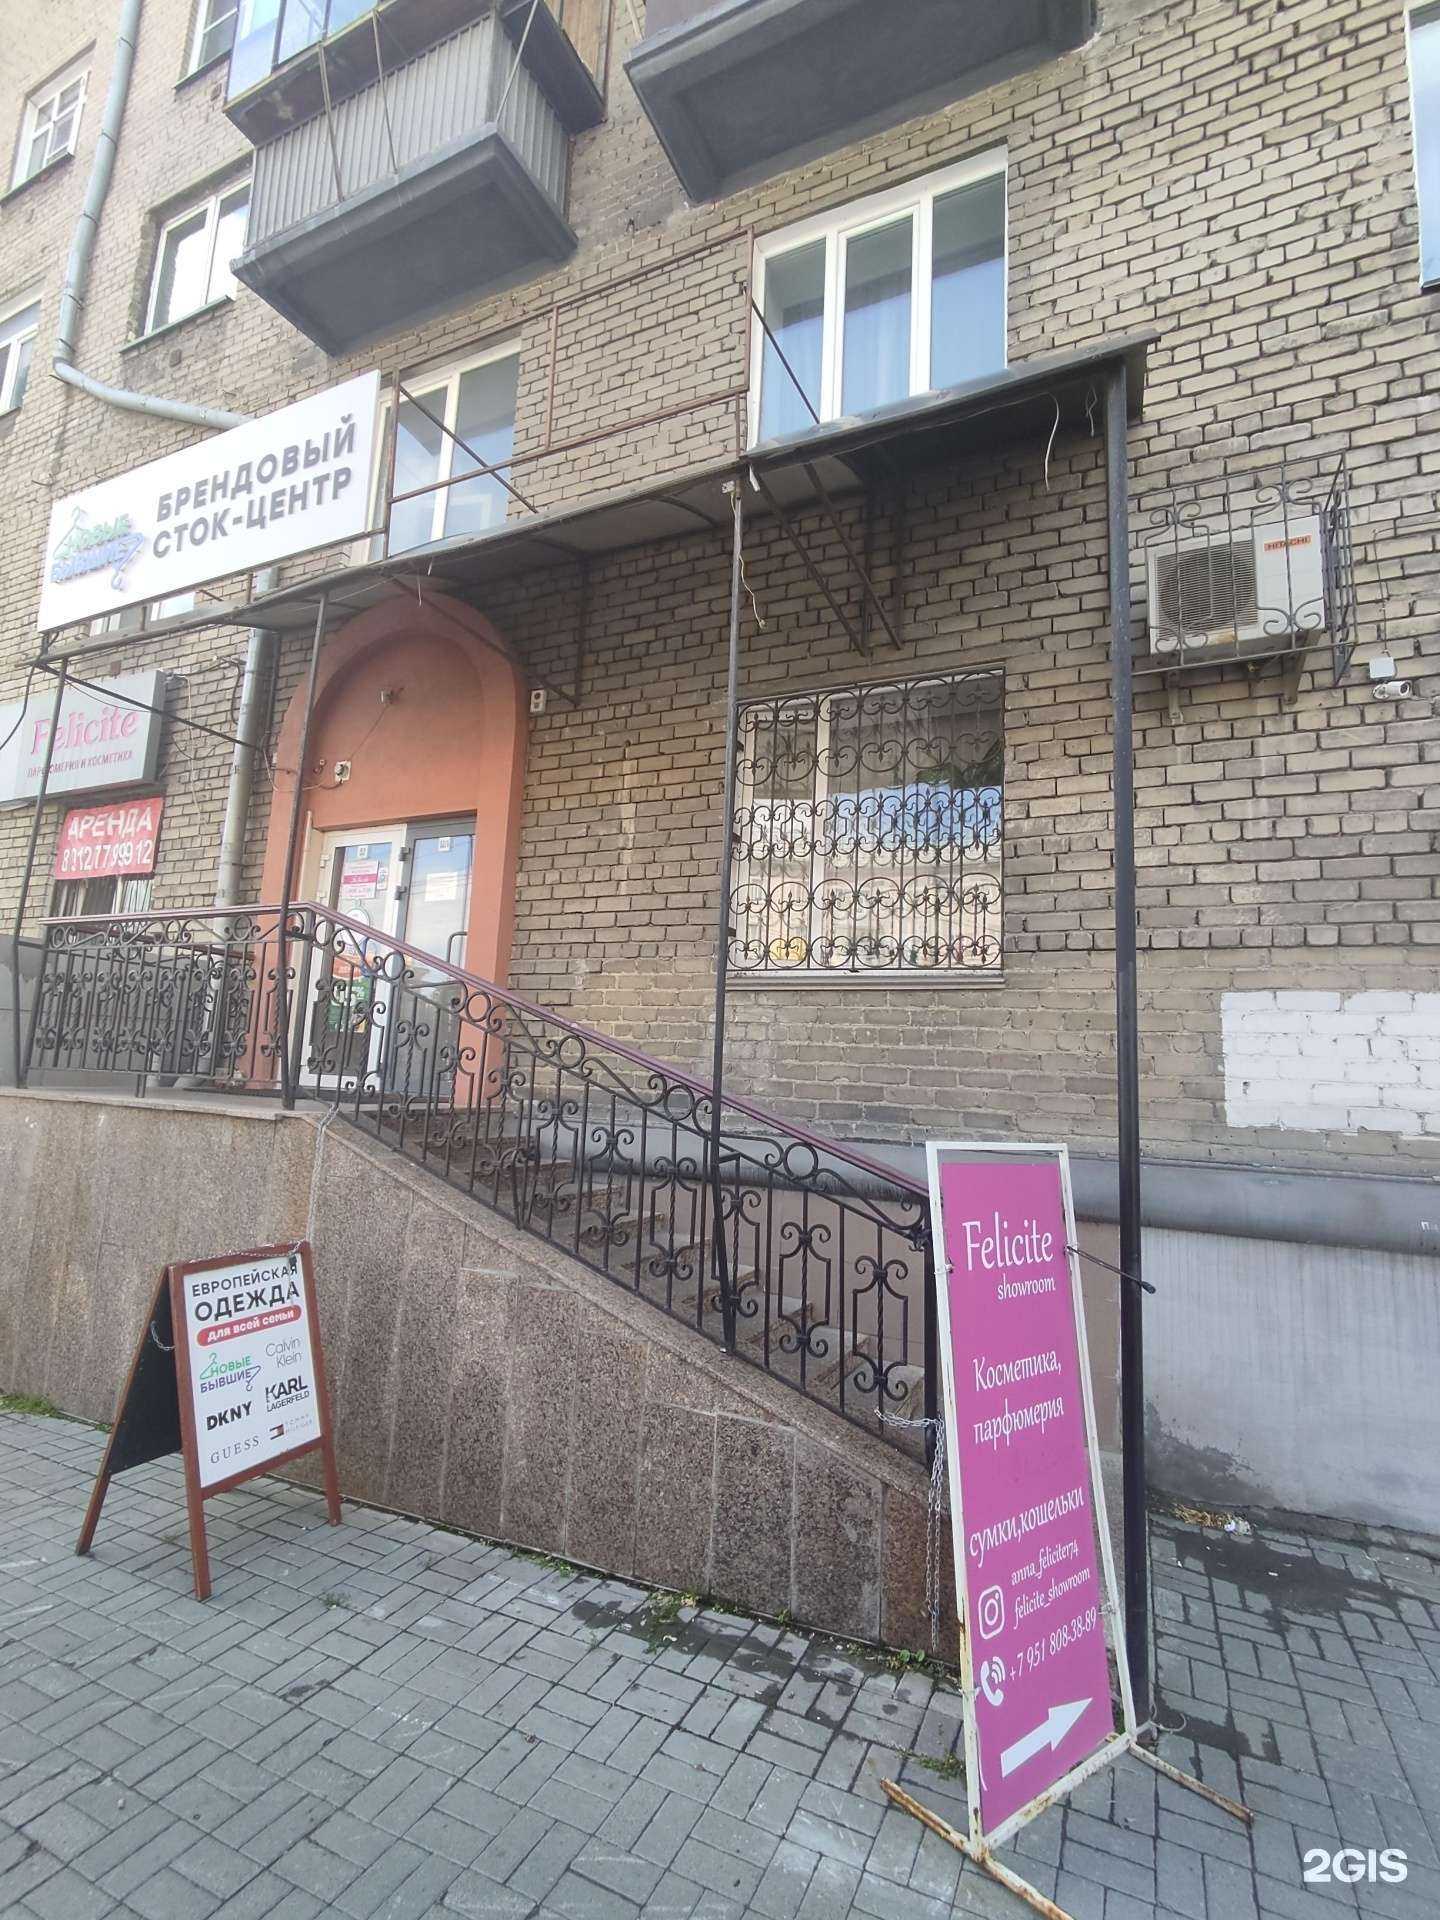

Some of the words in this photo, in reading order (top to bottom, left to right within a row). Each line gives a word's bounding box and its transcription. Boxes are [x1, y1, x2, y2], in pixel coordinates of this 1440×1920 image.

[156, 413, 357, 523] БРЕНДОВЫЙ
[152, 466, 352, 559] СТОК-ЦЕНТР
[31, 708, 139, 757] Felicite
[68, 806, 153, 841] АРЕНДА
[962, 1211, 1054, 1271] Felicite
[192, 1263, 298, 1297] ЕВРОПЕЙСКАЯ
[997, 1273, 1056, 1300] showroom
[195, 1281, 300, 1321] ОДЕЖДА
[207, 1327, 231, 1343] для
[233, 1317, 261, 1334] всей
[262, 1309, 295, 1326] семьи
[265, 1336, 301, 1357] Calvin
[276, 1351, 302, 1368] Klein
[200, 1369, 252, 1394] БЫВШИЕ
[210, 1355, 252, 1379] НОВЫЕ
[973, 1350, 1062, 1392] Косметика,
[265, 1375, 308, 1403] KARL
[267, 1390, 310, 1413] LAGERFELD
[206, 1401, 252, 1431] DKNY
[973, 1396, 1064, 1451] парфюмерия
[211, 1435, 260, 1464] GUESS
[1013, 1567, 1090, 1631] felicite_showroom
[1026, 1637, 1046, 1673] 951
[1049, 1606, 1097, 1656] 808-38-89
